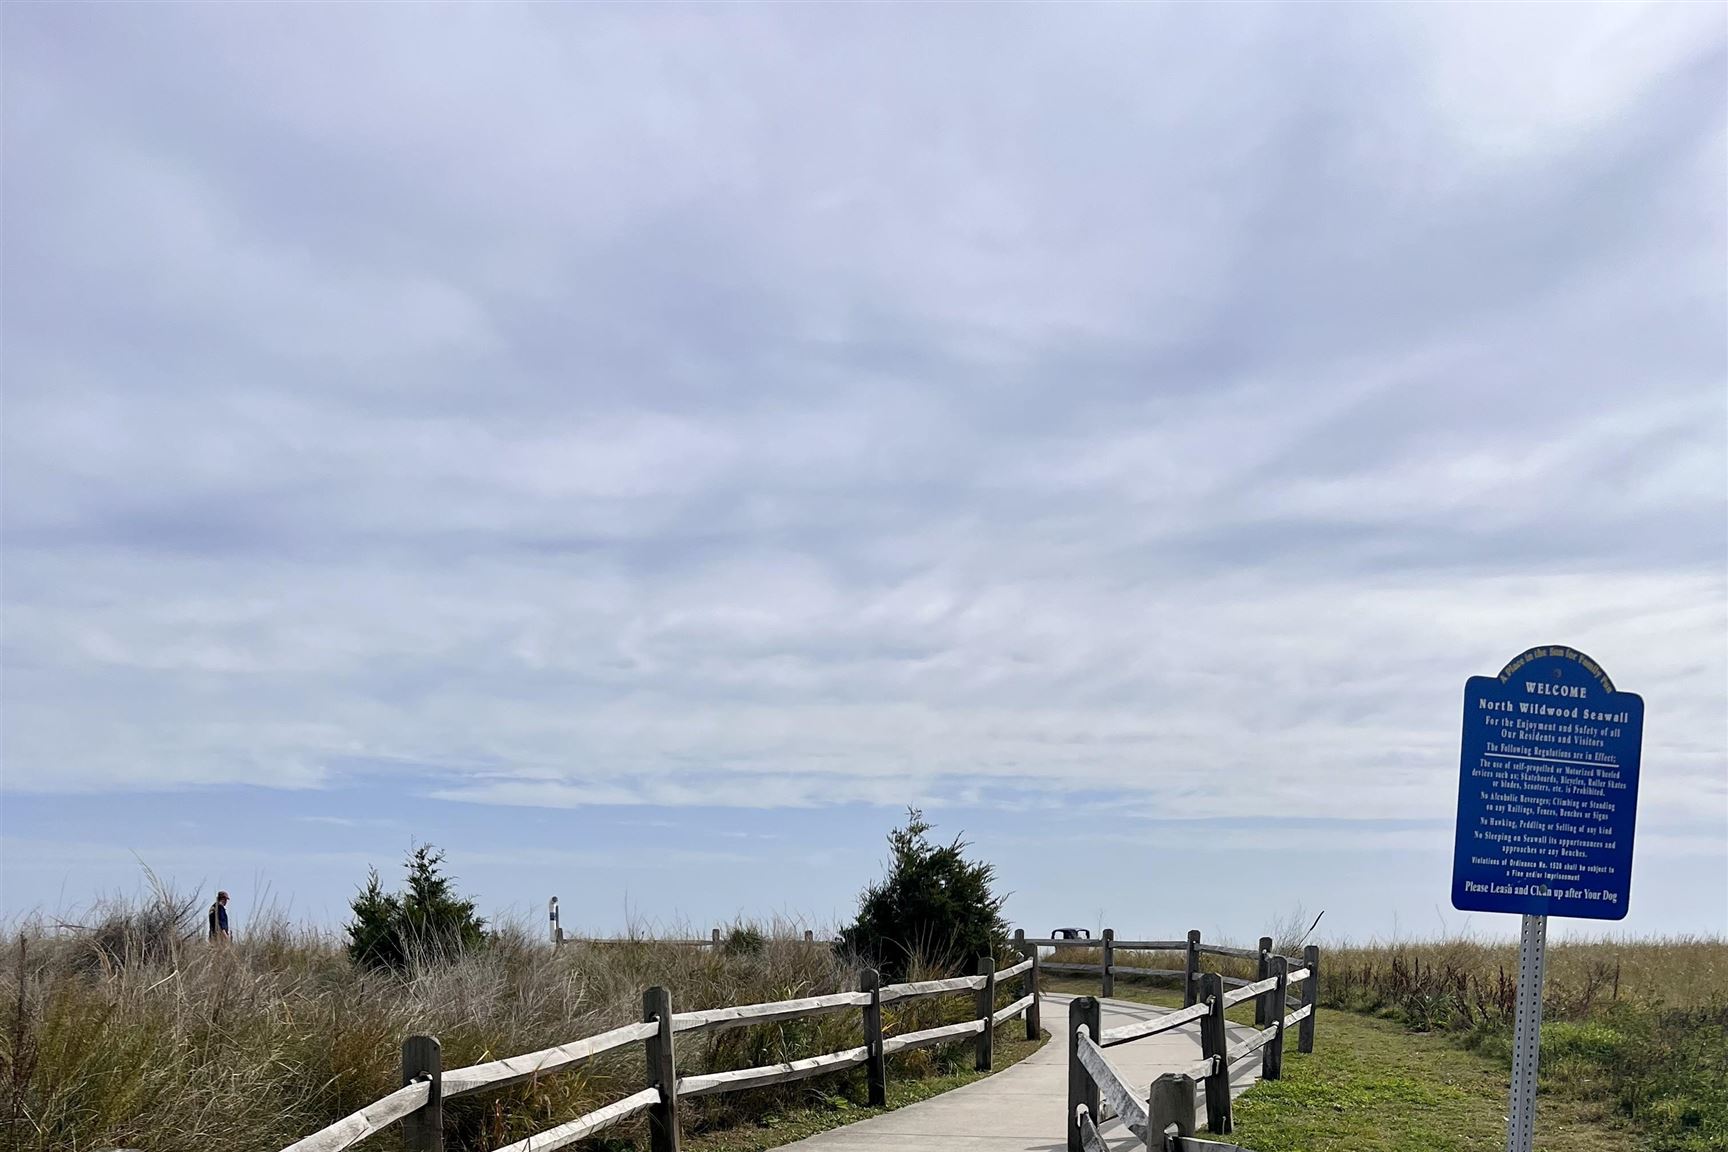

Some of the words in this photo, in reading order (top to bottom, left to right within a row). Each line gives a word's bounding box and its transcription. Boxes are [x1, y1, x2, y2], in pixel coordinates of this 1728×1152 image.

[1578, 655, 1602, 678] Family
[1525, 682, 1586, 698] WELCOME
[1479, 698, 1513, 711] North
[1519, 702, 1578, 718] Wildwood
[1583, 709, 1628, 723] Seawall
[1485, 715, 1499, 726] For
[1501, 717, 1514, 727] the
[1516, 718, 1556, 731] Enjoyment
[1558, 723, 1572, 733] and
[1574, 724, 1598, 737] Safety
[1600, 727, 1608, 736] of
[1610, 728, 1620, 737] all
[1501, 728, 1516, 739] Our
[1519, 730, 1555, 742] Residents
[1557, 735, 1571, 744] and
[1574, 735, 1604, 747] Visitors
[1486, 742, 1498, 751] The
[1500, 743, 1531, 756] Following
[1534, 746, 1571, 758] Regulations
[1585, 751, 1592, 760] in
[1480, 758, 1490, 767] The
[1504, 761, 1510, 769] of
[1512, 762, 1554, 773] self-propelled
[1564, 766, 1594, 776] Motorized
[1596, 769, 1620, 779] Wheeled
[1472, 768, 1493, 777] devices
[1495, 770, 1508, 778] such
[1520, 772, 1558, 784] Skateboards,
[1560, 775, 1586, 787] Bicycles,
[1588, 778, 1606, 787] Roller
[1607, 780, 1626, 789] Skates
[1500, 779, 1522, 789] blades,
[1565, 785, 1571, 793] is
[1572, 786, 1605, 796] Prohibited.
[1480, 791, 1488, 799] No
[1490, 792, 1518, 802] Alcoholic
[1552, 797, 1579, 808] Climbing
[1589, 800, 1615, 811] Standing
[1495, 805, 1505, 813] any
[1507, 804, 1534, 815] Railings,
[1536, 806, 1558, 816] Fences,
[1560, 808, 1582, 818] Benches
[1592, 811, 1608, 821] Signs
[1480, 816, 1488, 825] No
[1519, 819, 1545, 831] Peddling
[1555, 822, 1576, 834] Selling
[1474, 830, 1482, 838] No
[1484, 831, 1511, 842] Sleeping
[1523, 834, 1547, 843] Seawall
[1548, 836, 1557, 844] its
[1502, 845, 1537, 854] approaches
[1548, 848, 1558, 857] any
[1561, 848, 1587, 857] Benches.
[1472, 856, 1499, 865] Violations
[1509, 859, 1536, 868] Ordinance
[1587, 865, 1607, 873] subject
[1544, 872, 1580, 880] Imprisonment
[1465, 880, 1488, 892] Please
[1490, 882, 1512, 894] Leash
[1514, 884, 1528, 895] and
[1553, 889, 1563, 900] up
[1564, 887, 1582, 898] after
[1584, 888, 1601, 899] Your
[1602, 889, 1617, 903] Dog
